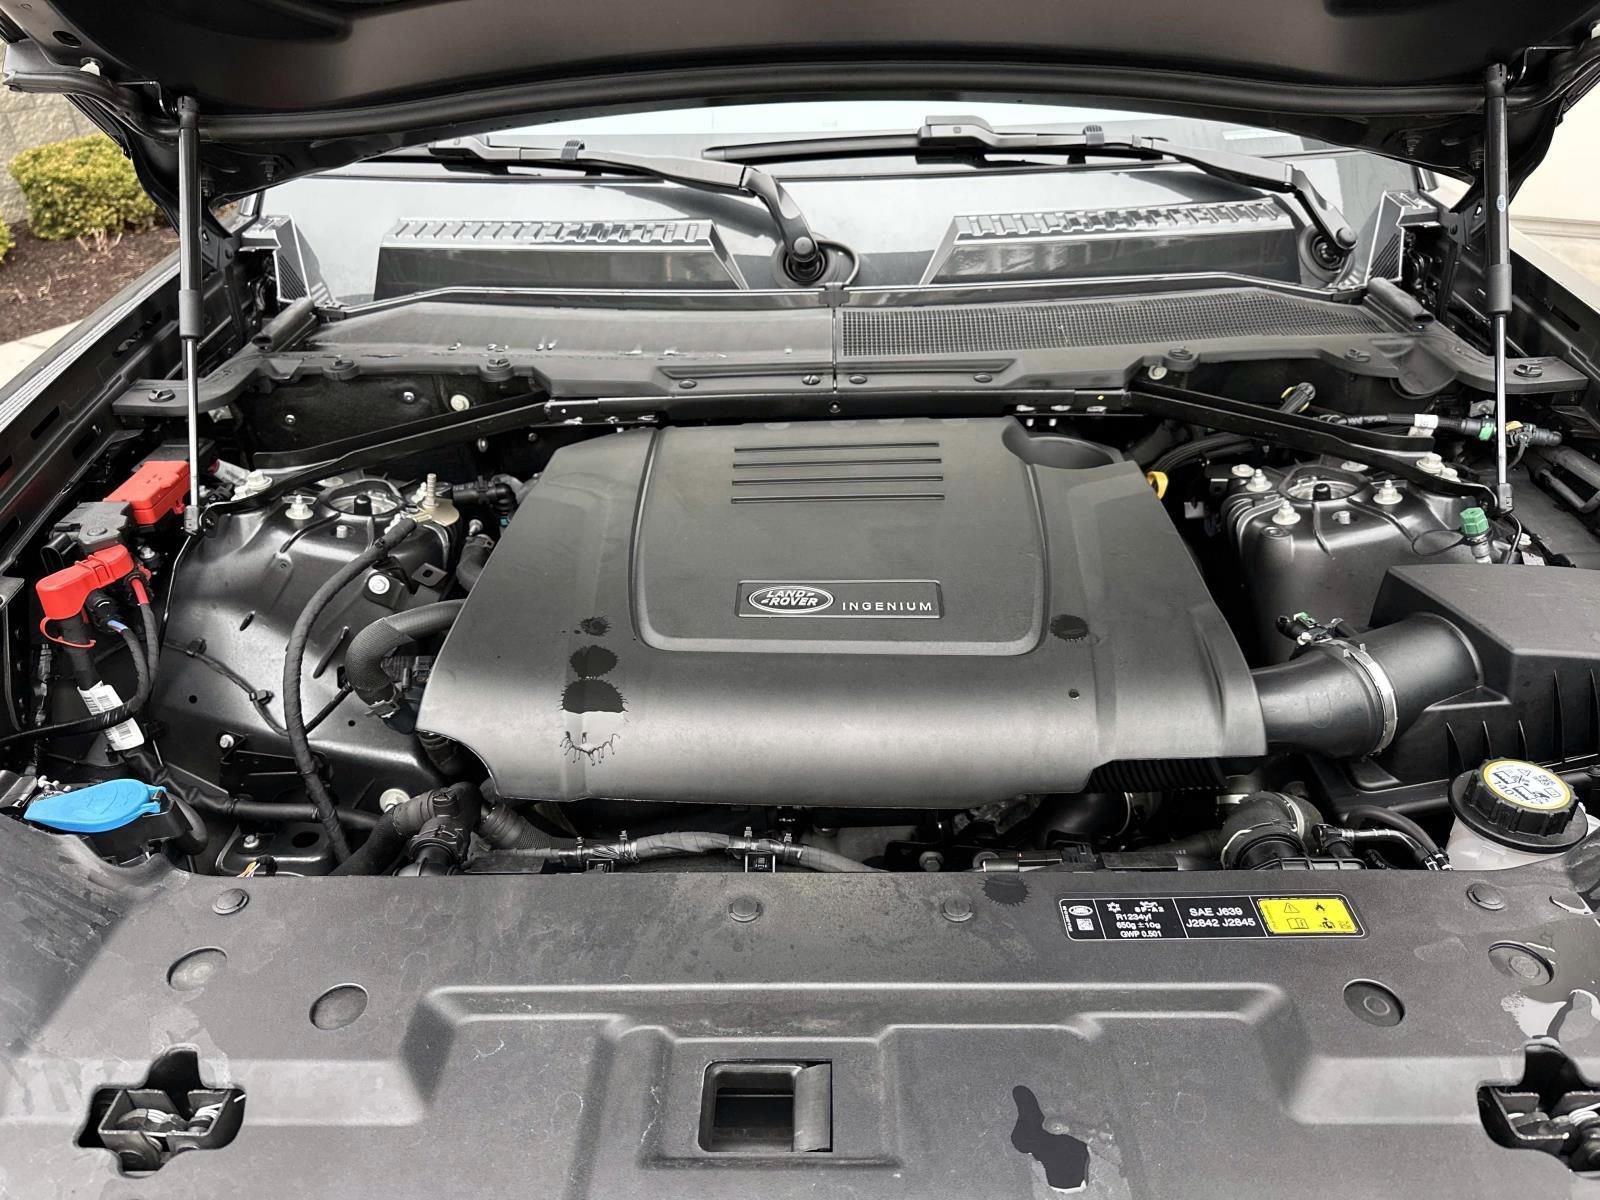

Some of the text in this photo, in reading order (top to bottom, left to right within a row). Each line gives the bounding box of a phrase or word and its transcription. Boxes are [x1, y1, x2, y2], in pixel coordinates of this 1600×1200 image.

[766, 589, 805, 598] LAND
[768, 597, 818, 606] ROVER
[842, 602, 932, 611] INGENIUM
[1189, 907, 1243, 917] SAE J639
[1186, 917, 1256, 927] J2842 J2845
[1120, 930, 1140, 938] GWP
